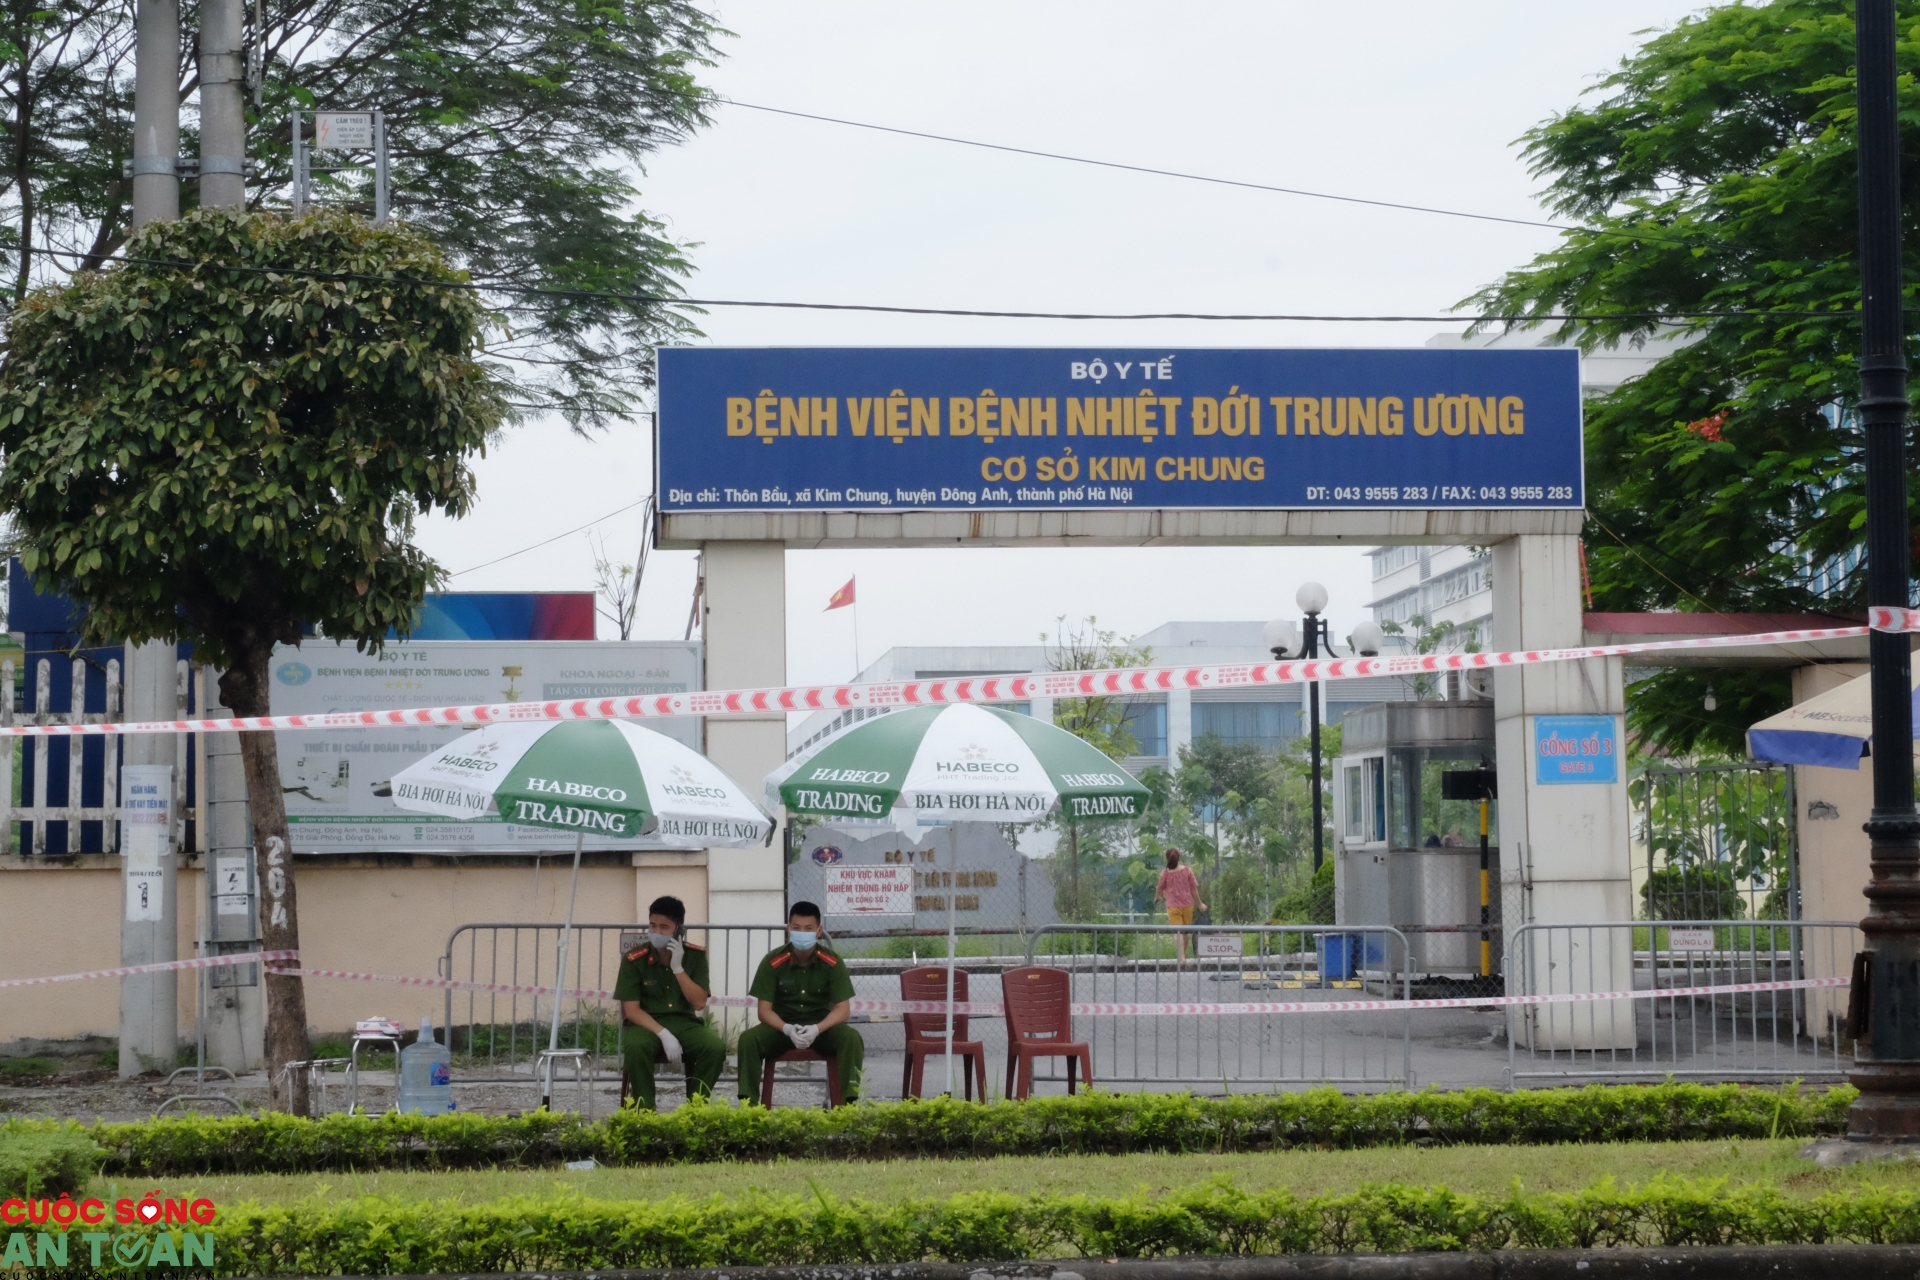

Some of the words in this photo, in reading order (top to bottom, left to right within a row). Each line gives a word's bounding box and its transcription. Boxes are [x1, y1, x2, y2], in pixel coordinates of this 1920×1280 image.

[1071, 358, 1108, 385] BỘ
[1114, 362, 1132, 380] Y
[1140, 355, 1176, 380] TẾ
[727, 389, 838, 444] BỆNH
[847, 389, 940, 444] VIỆN
[949, 389, 1057, 444] BỆNH
[1066, 388, 1182, 443] NHIỆT
[1191, 385, 1261, 437] ĐỚI
[1270, 396, 1404, 437] TRUNG
[1413, 393, 1524, 437] ƯƠNG
[981, 454, 1027, 482] CƠ
[1036, 447, 1080, 482] SỞ
[1089, 457, 1146, 482] KIM
[1155, 456, 1265, 482] CHUNG
[669, 488, 693, 505] Địa
[697, 487, 720, 503] chỉ:
[724, 488, 758, 503] Thôn
[762, 486, 791, 506] Bầu,
[795, 489, 811, 503] xã
[815, 488, 841, 503] Kim
[845, 488, 892, 506] Chung,
[896, 488, 937, 506] huyện
[941, 488, 976, 505] Đông
[981, 488, 1013, 505] Anh,
[1017, 487, 1055, 502] thành
[1059, 485, 1086, 505] phố
[1088, 487, 1106, 502] Hà
[1110, 486, 1133, 504] Nội
[1307, 487, 1330, 501] ĐT:
[1334, 487, 1361, 501] 043
[1365, 487, 1399, 501] 9555
[1402, 487, 1429, 501] 283
[1432, 487, 1438, 501] /
[1442, 487, 1476, 501] FAX:
[1479, 487, 1506, 501] 043
[1510, 486, 1543, 500] 9555
[1547, 486, 1573, 500] 283
[381, 651, 399, 663] BỘ
[401, 652, 409, 661] Y
[413, 650, 428, 661] TẾ
[317, 667, 341, 678] BỆNH
[343, 667, 362, 678] VIỆN
[364, 667, 388, 678] BỆNH
[389, 667, 414, 679] NHIỆT
[416, 667, 431, 677] ĐỚI
[433, 668, 462, 677] TRUNG
[464, 668, 490, 677] ƯƠNG
[560, 670, 594, 679] KHOA
[598, 670, 635, 680] NGOẠI
[594, 684, 625, 695] CÔNG
[304, 740, 330, 753] THIẾT
[1539, 731, 1578, 756] CỔNG
[1581, 731, 1600, 756] SỐ
[1603, 738, 1613, 756] 3
[438, 754, 498, 772] HABECO
[936, 762, 1020, 773] HABECO
[1559, 761, 1586, 773] GATE
[1587, 761, 1595, 773] 3
[447, 767, 473, 778] Trading
[809, 767, 891, 784] HABECO
[963, 774, 1000, 782] Trading
[1060, 773, 1125, 787] HABECO
[526, 777, 627, 802] HABECO
[662, 783, 727, 799] HABECO
[397, 783, 419, 800] BIA
[421, 786, 445, 803] HƠI
[445, 788, 462, 807] HÀ
[463, 791, 486, 813] NỘI
[796, 789, 883, 814] TRADING
[915, 794, 944, 810] BIA
[948, 794, 981, 810] HƠI
[985, 791, 1010, 811] HÀ
[1014, 793, 1047, 815] NỘI
[1071, 796, 1135, 816] TRADING
[516, 800, 626, 833] TRADING
[662, 819, 681, 835] BIA
[684, 820, 709, 836] HƠI
[712, 819, 731, 838] HÀ
[734, 821, 759, 843] NỘI
[907, 851, 915, 863] Y
[919, 847, 936, 863] TẾ
[840, 870, 856, 879] KHU
[857, 870, 872, 880] VỰC
[874, 869, 897, 879] KHÁM
[854, 882, 879, 893] TRÙNG
[881, 882, 892, 893] HÔ
[894, 881, 909, 893] HẤP
